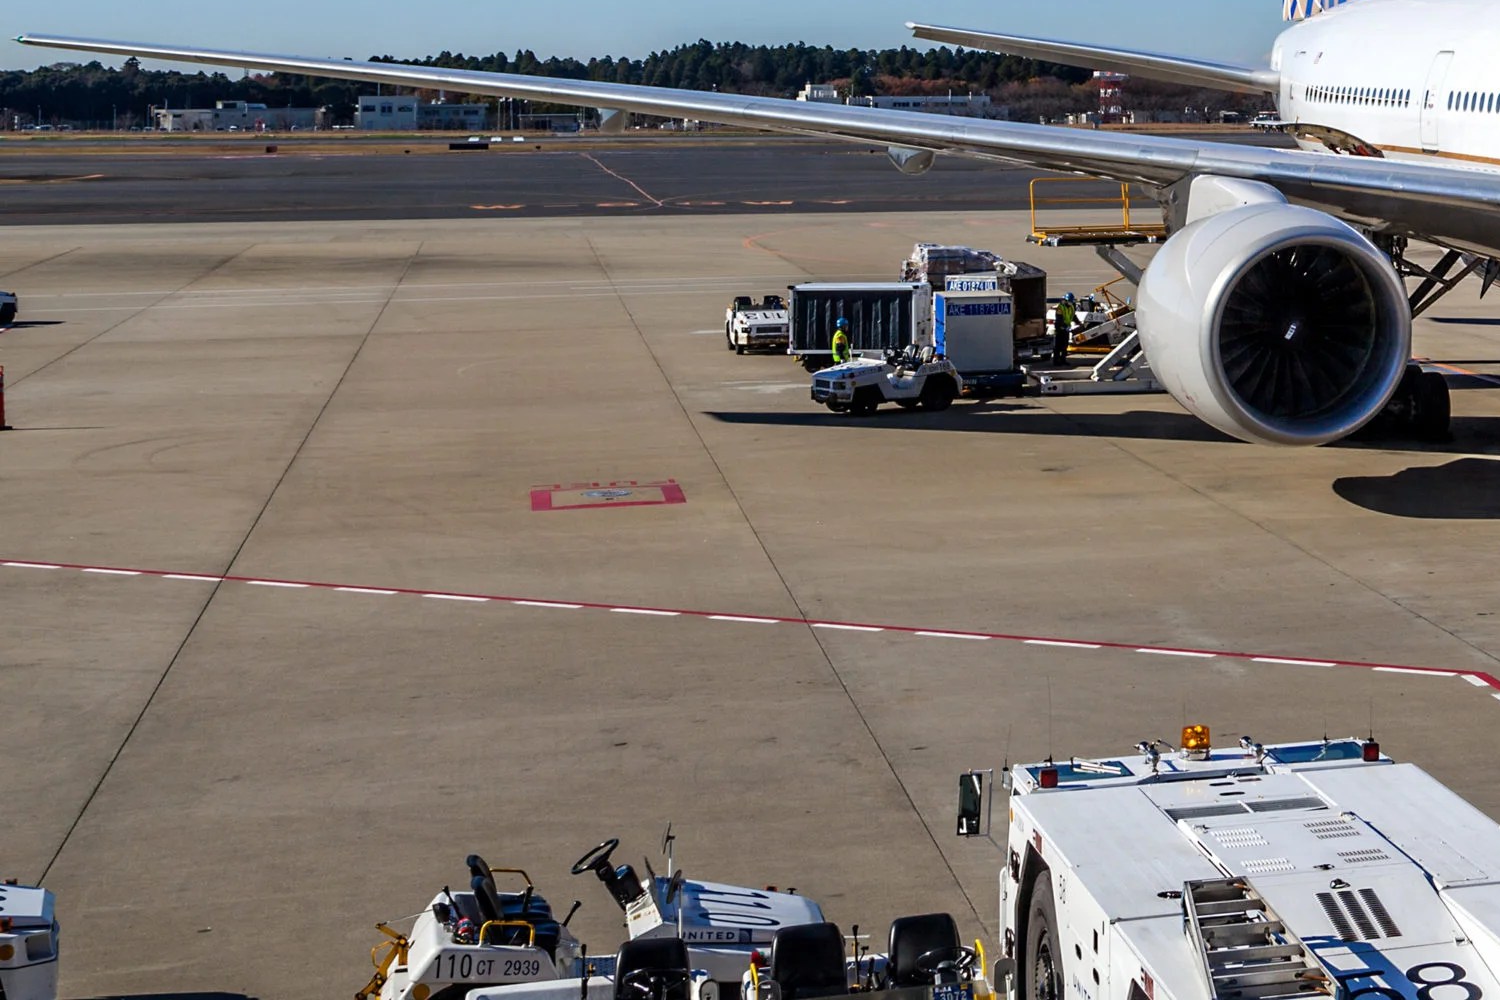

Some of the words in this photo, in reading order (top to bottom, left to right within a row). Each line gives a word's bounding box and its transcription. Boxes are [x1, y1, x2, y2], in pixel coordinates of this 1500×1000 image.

[949, 281, 962, 291] AKE
[948, 304, 965, 316] AKE
[998, 302, 1009, 314] UA
[434, 953, 473, 979] 110
[476, 959, 495, 976] CT
[503, 959, 541, 976] 2939
